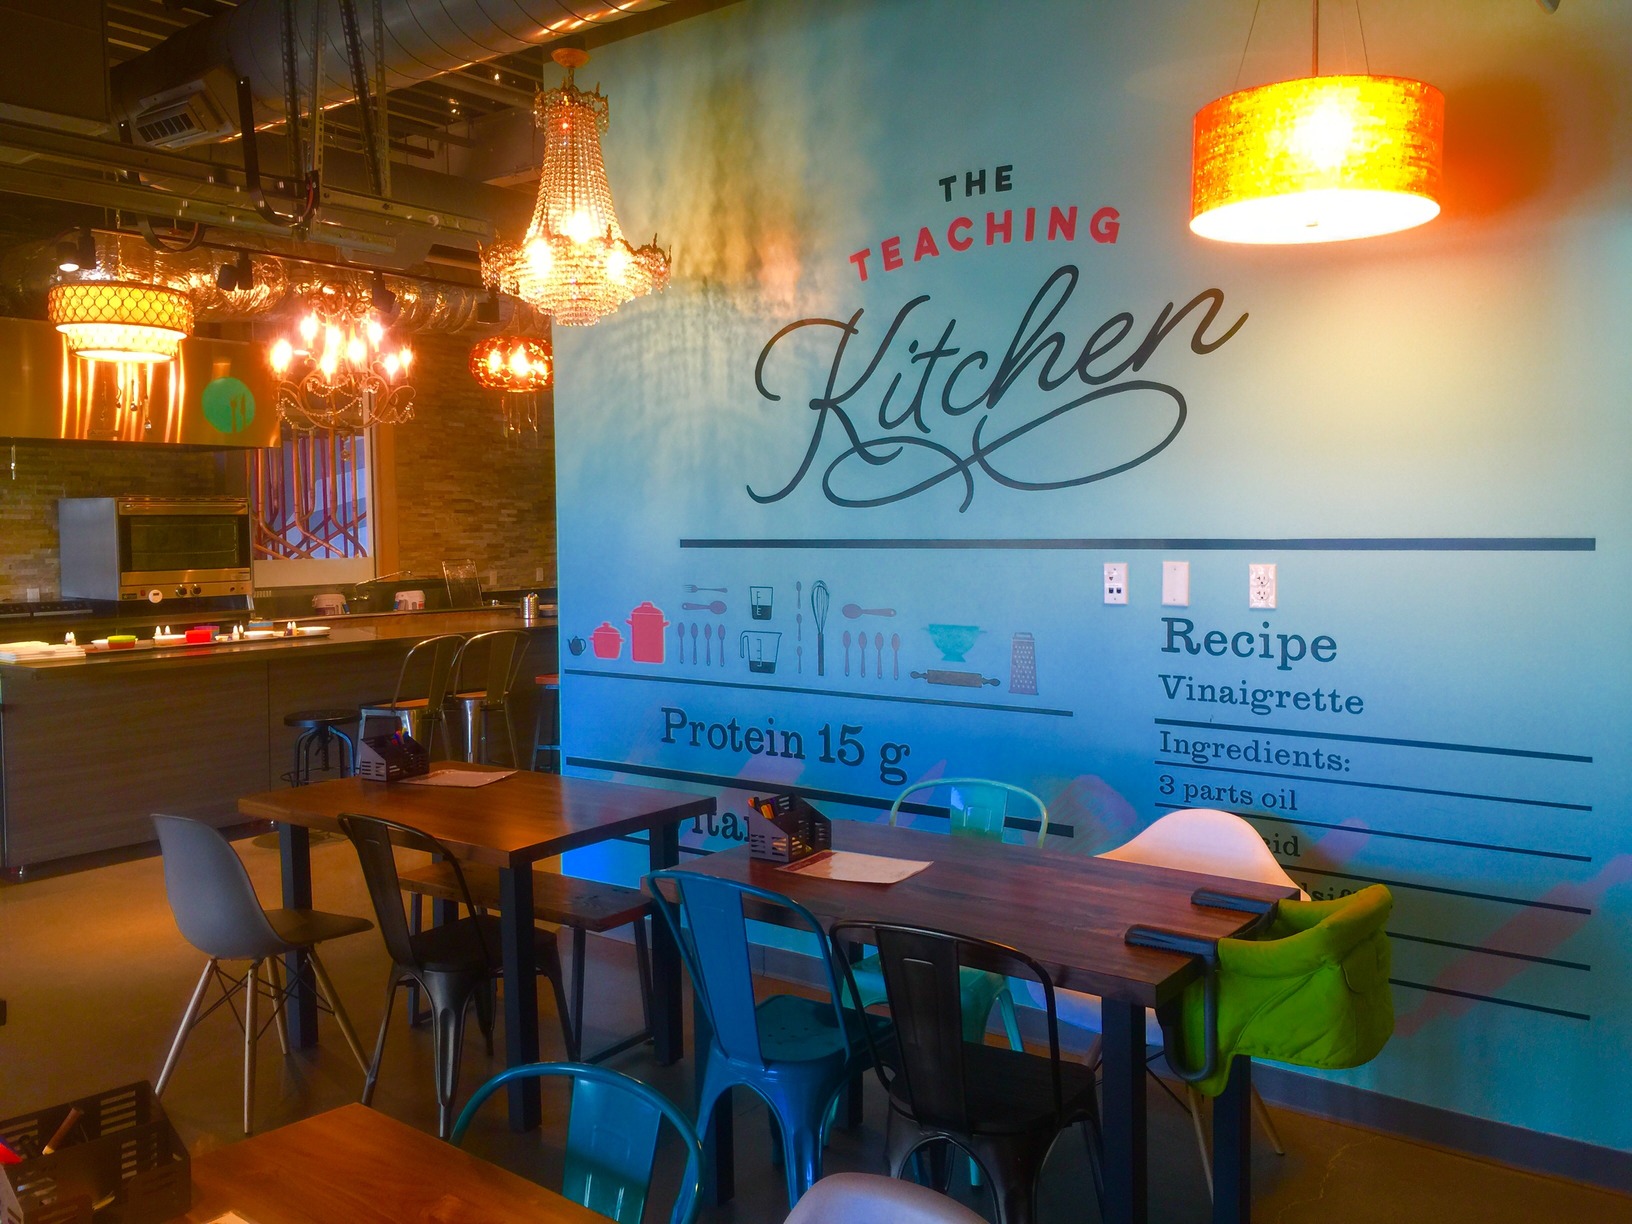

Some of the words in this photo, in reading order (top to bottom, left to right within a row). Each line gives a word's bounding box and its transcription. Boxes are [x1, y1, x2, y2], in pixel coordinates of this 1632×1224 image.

[938, 164, 1013, 203] THE
[849, 205, 1121, 282] TEACHING
[746, 264, 1249, 513] Kitchen
[1161, 617, 1338, 671] Recipe
[1158, 674, 1364, 716] Vinaigrette
[660, 706, 806, 760] Protein
[818, 722, 865, 767] 15
[879, 741, 911, 786] g
[1159, 730, 1351, 773] Ingredients:
[1159, 774, 1176, 796] 3
[1183, 783, 1254, 806] parts
[1261, 788, 1299, 811] oil
